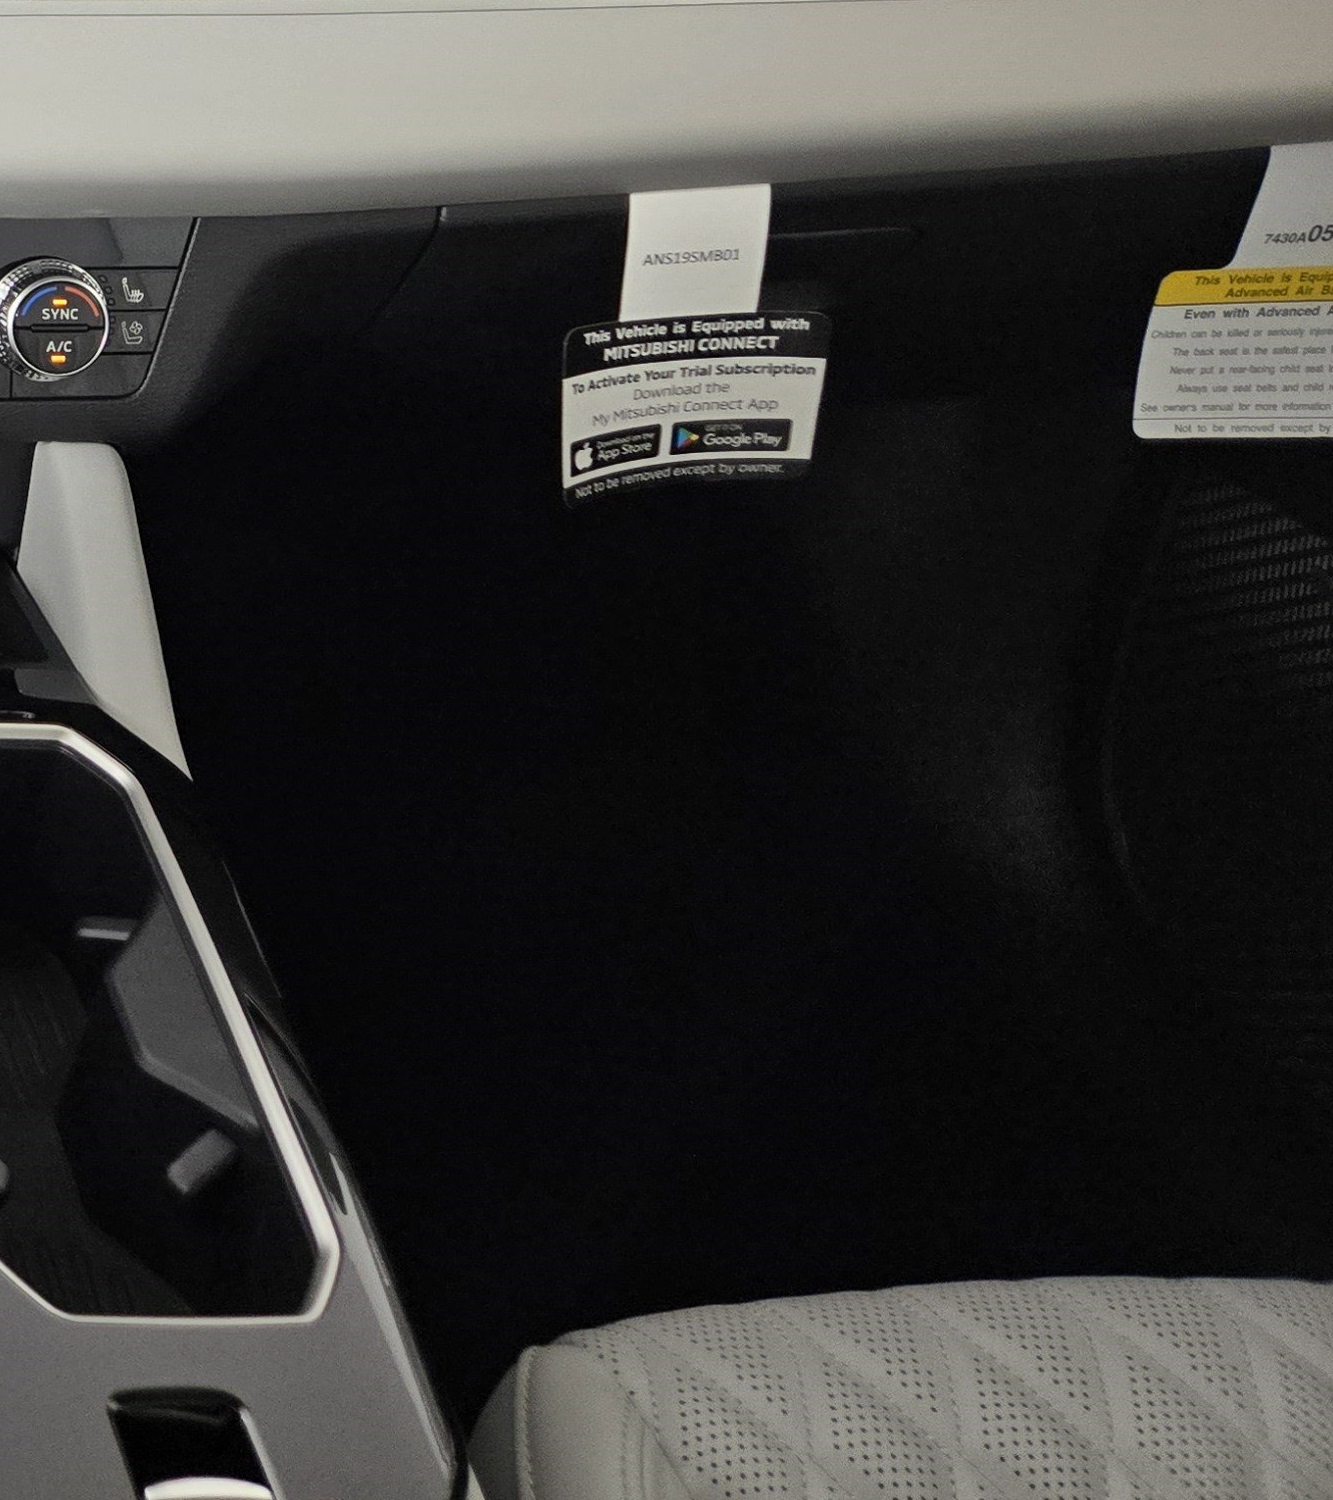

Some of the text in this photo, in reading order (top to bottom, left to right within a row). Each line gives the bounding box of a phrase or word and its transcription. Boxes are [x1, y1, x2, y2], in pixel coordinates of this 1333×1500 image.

[1195, 276, 1220, 286] This
[1229, 273, 1274, 285] Vehicle
[1225, 285, 1314, 299] Advanced Air
[42, 308, 78, 320] SYNC
[1184, 306, 1321, 320] Even with Advanced
[584, 317, 811, 346] This Vehicle is Equipped with
[46, 341, 72, 353] A/C
[603, 335, 779, 362] MITSUBISHI CONNECT
[572, 362, 816, 395] To Activate Your Trial Subscription
[633, 382, 730, 400] Download the
[592, 399, 779, 427] My Mitsubishi Connect App
[1140, 403, 1158, 412] See
[703, 432, 782, 447] Google Play
[597, 442, 653, 462] App Store
[575, 485, 592, 499] Not
[594, 481, 605, 492] to
[607, 478, 619, 490] be
[621, 467, 671, 484] removed
[673, 464, 716, 477] except
[718, 463, 735, 475] by
